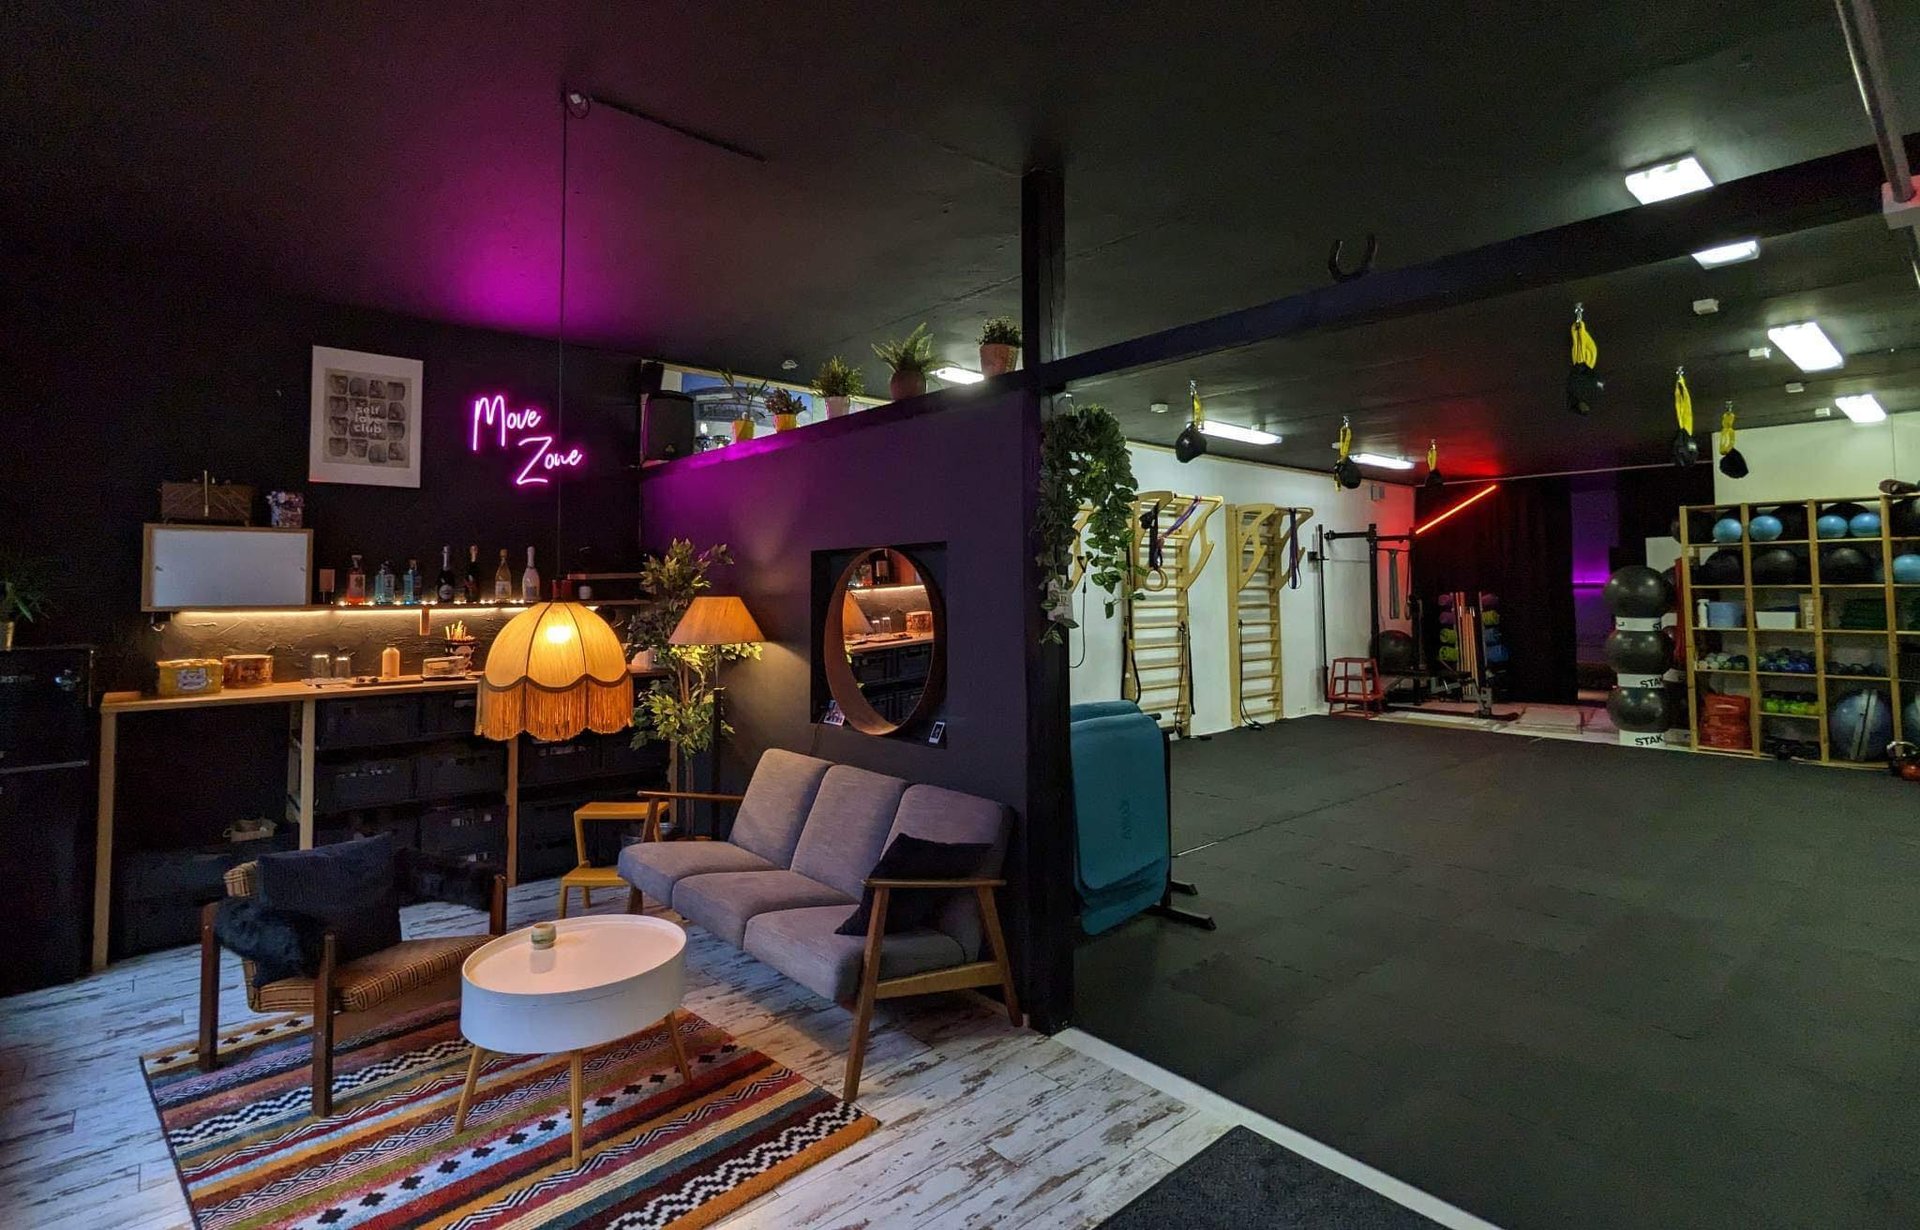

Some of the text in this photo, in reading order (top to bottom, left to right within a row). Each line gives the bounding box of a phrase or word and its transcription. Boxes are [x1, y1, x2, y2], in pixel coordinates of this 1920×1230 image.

[356, 405, 381, 415] self
[472, 395, 542, 451] Move
[353, 423, 382, 433] club
[516, 436, 583, 485] Zone
